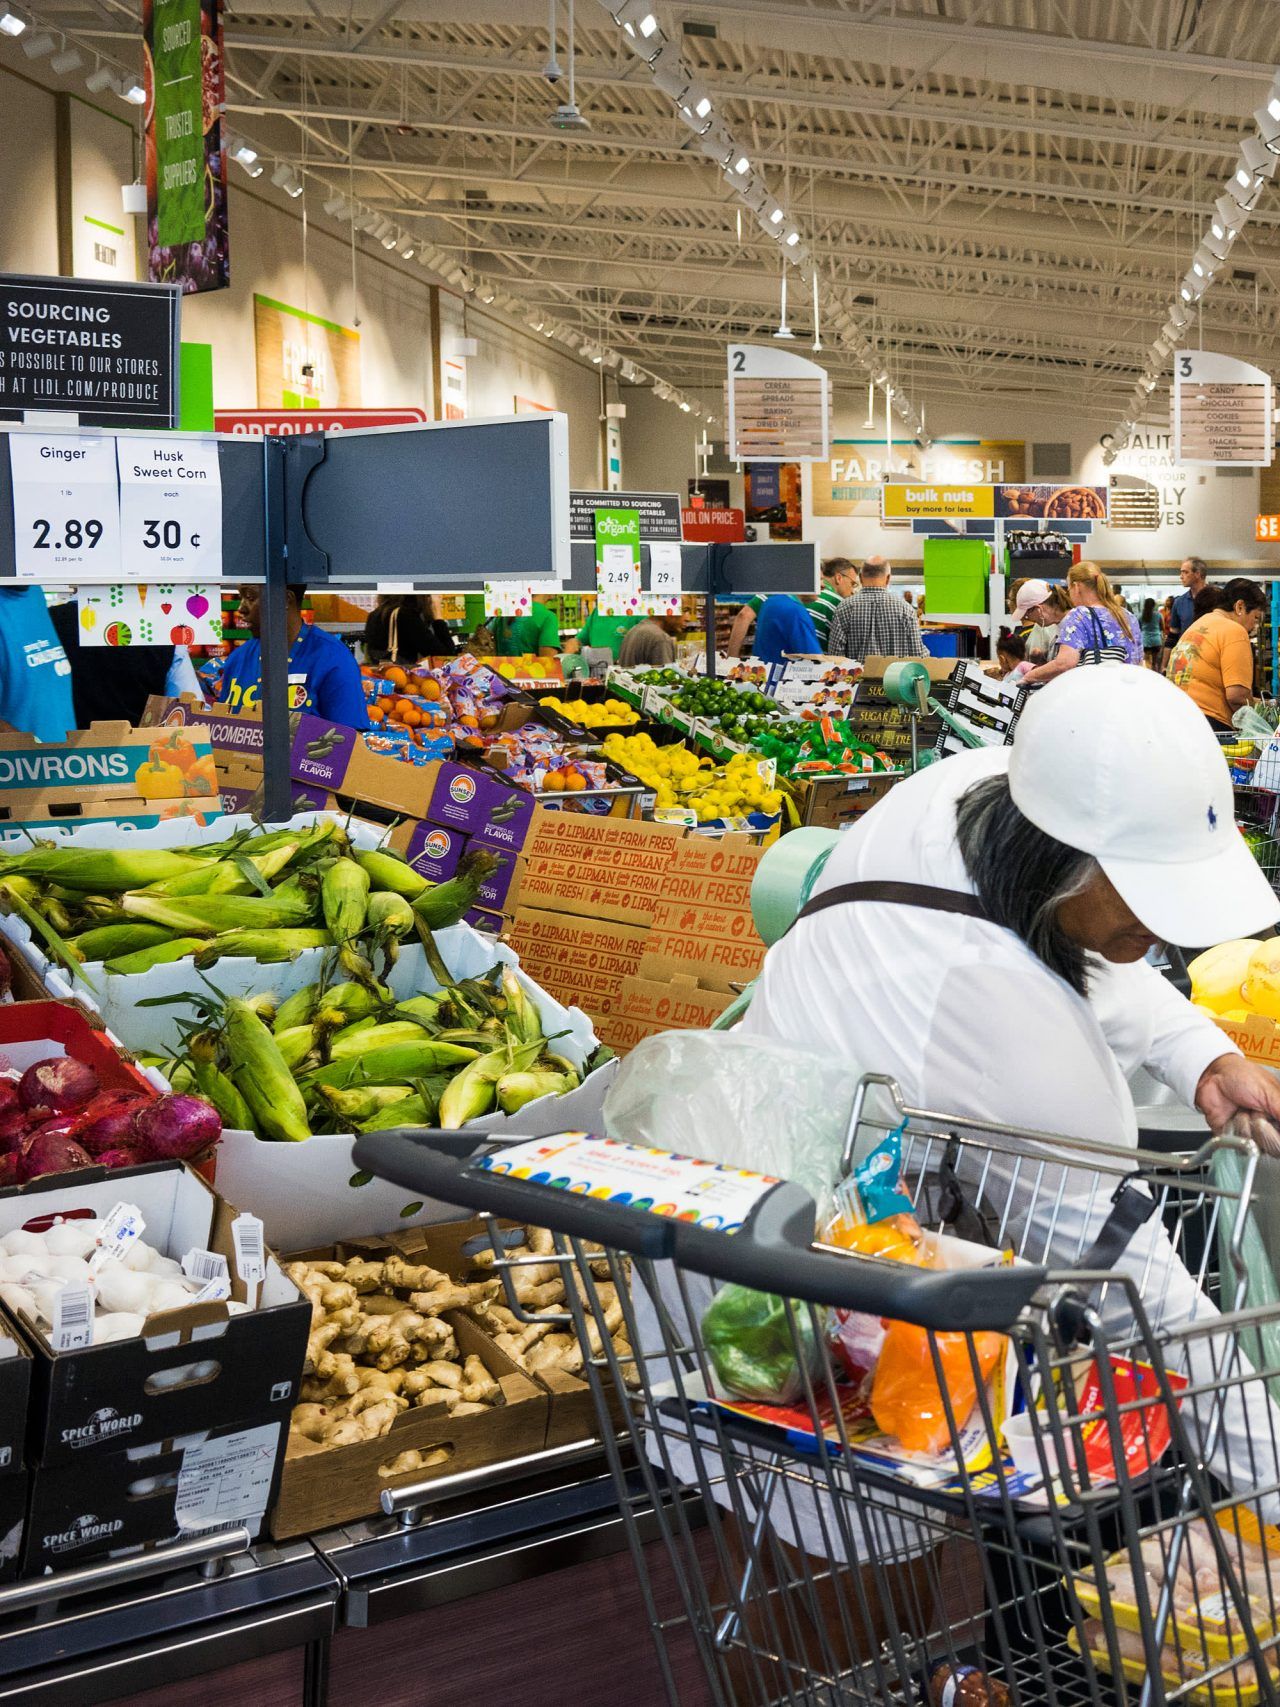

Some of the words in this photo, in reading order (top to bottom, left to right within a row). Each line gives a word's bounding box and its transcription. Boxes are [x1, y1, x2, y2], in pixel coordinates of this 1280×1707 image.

[163, 20, 191, 53] SOURCED
[165, 110, 193, 141] TRUSTED
[164, 158, 197, 190] SUPPLIERS
[8, 301, 110, 323] SOURCING
[8, 327, 122, 349] VEGETABLES
[11, 352, 65, 371] POSSIBLE
[71, 355, 84, 372] TO
[90, 356, 111, 373] OUR
[116, 358, 163, 376] STORES.
[733, 351, 745, 371] 2
[1180, 357, 1192, 377] 3
[13, 377, 27, 394] AT
[34, 378, 159, 400] LIDL.COM/PRODUCE
[40, 446, 86, 462] Ginger
[153, 450, 184, 462] Husk
[133, 466, 172, 478] Sweet
[177, 467, 207, 479] Corn
[585, 499, 620, 507] COMMITTED
[906, 489, 938, 502] bulk
[943, 490, 974, 502] nuts
[699, 511, 711, 525] ON
[906, 506, 920, 514] buy
[944, 505, 956, 513] for
[33, 519, 104, 549] 2.89
[143, 520, 181, 549] 30
[598, 516, 637, 536] Organic
[608, 572, 629, 583] 2.49
[658, 573, 669, 583] 29
[860, 711, 888, 721] SUGAR
[1269, 743, 1278, 752] to
[299, 763, 333, 780] FLAVOR
[301, 758, 324, 769] INSPIRED
[325, 764, 334, 772] BY
[450, 786, 474, 797] SUNSET
[484, 827, 513, 843] FLAVOR
[486, 823, 504, 834] INSPIRED
[505, 828, 514, 836] BY
[566, 824, 605, 842] LIPMAN
[620, 831, 647, 847] FARM
[425, 841, 449, 852] SUNSET
[554, 842, 583, 859] FRESH
[623, 852, 663, 871] LIPMAN
[528, 879, 553, 895] FARM
[554, 883, 584, 900] FRESH
[576, 867, 616, 885] LIPMAN
[630, 875, 659, 892] FARM
[660, 876, 701, 900] FARM
[705, 882, 751, 906] FRESH
[540, 926, 579, 946] LIPMAN
[594, 934, 625, 951] FARM
[625, 940, 647, 956] FRE
[529, 943, 557, 961] FRESH
[598, 959, 640, 977] LIPMAN
[664, 938, 709, 961] FARM
[710, 943, 764, 970] FRESH
[553, 968, 597, 989] LIPMAN
[61, 1424, 96, 1443] SPICE
[100, 1414, 143, 1433] WORLD
[42, 1530, 76, 1549] SPICE
[80, 1519, 124, 1538] WORLD
